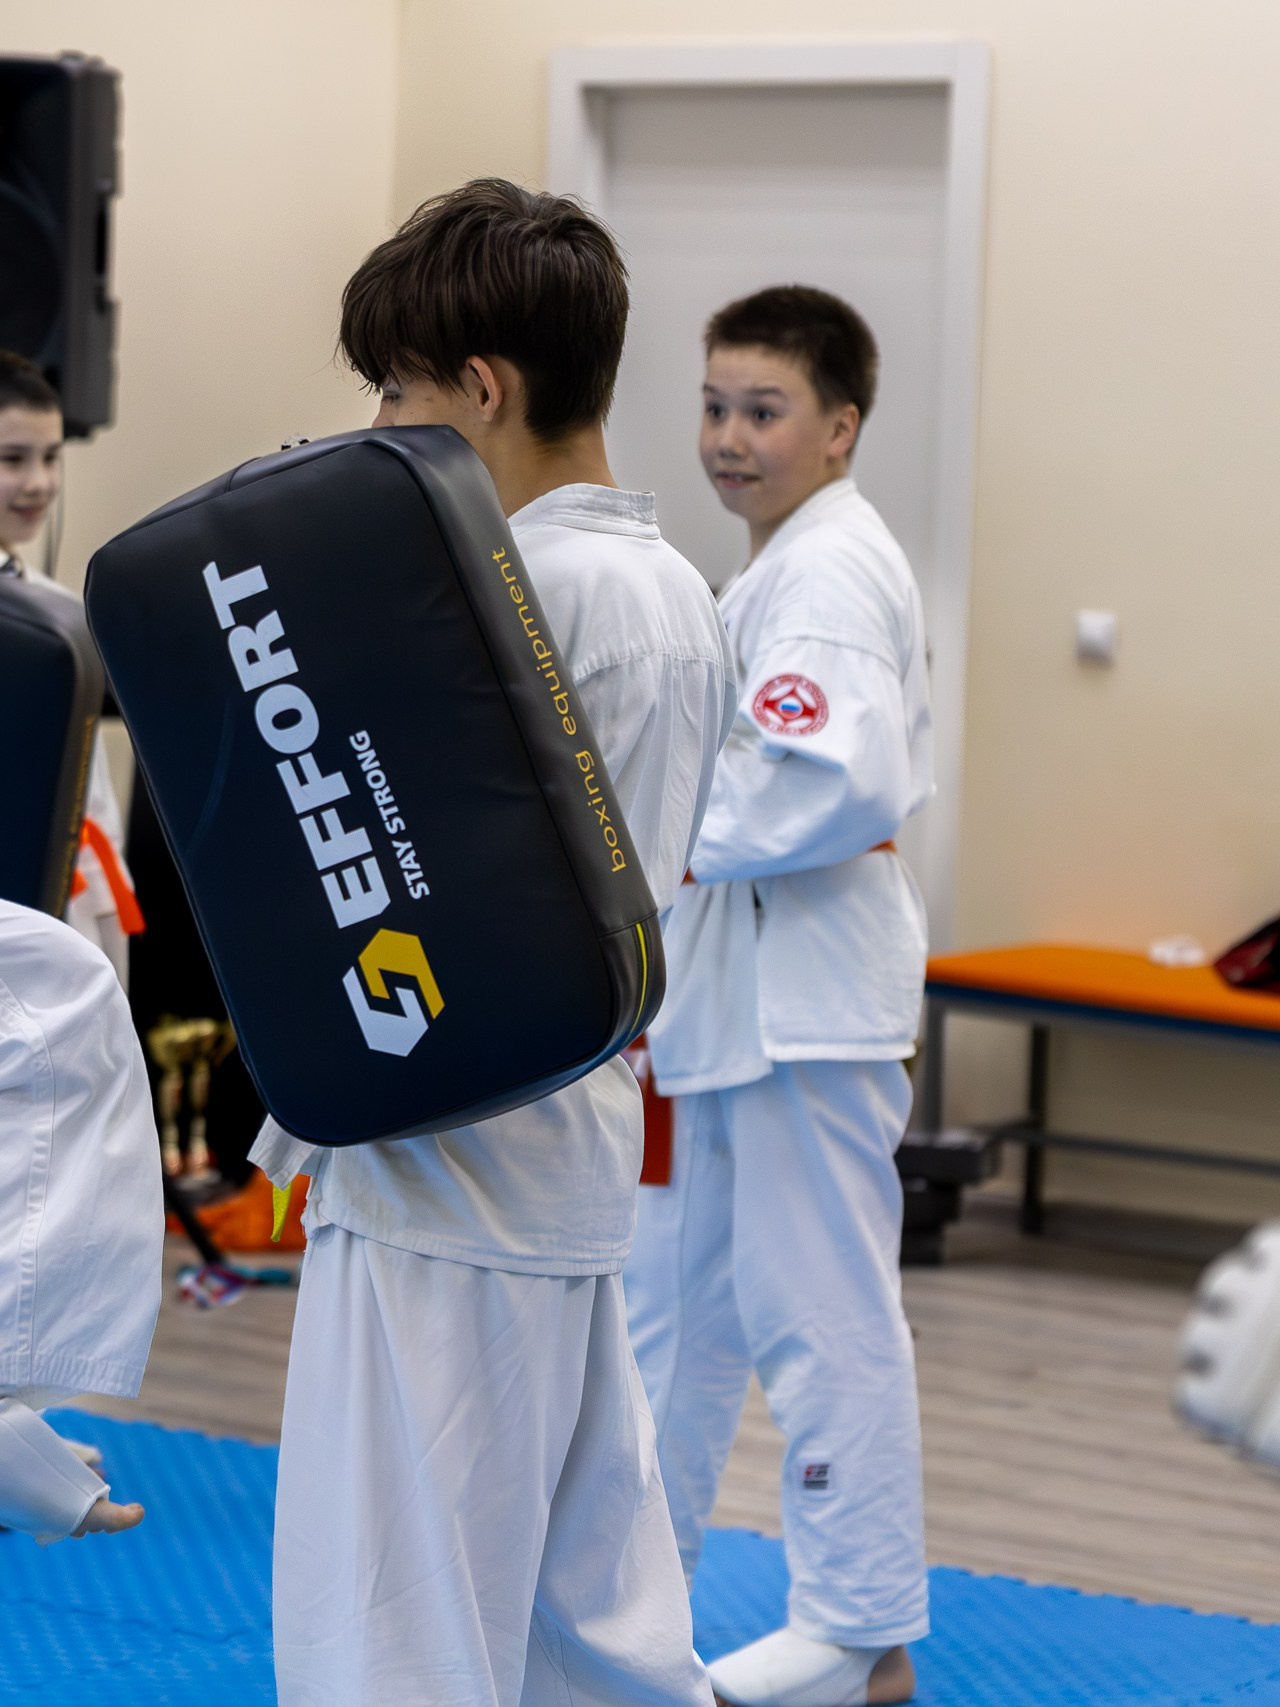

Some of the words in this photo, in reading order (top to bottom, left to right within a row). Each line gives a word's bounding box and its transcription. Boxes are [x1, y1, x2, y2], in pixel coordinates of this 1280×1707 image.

[492, 547, 577, 736] equipment
[201, 560, 391, 929] EFFORT
[349, 730, 407, 835] STRONG
[391, 840, 431, 900] STAY
[575, 750, 627, 873] boxing
